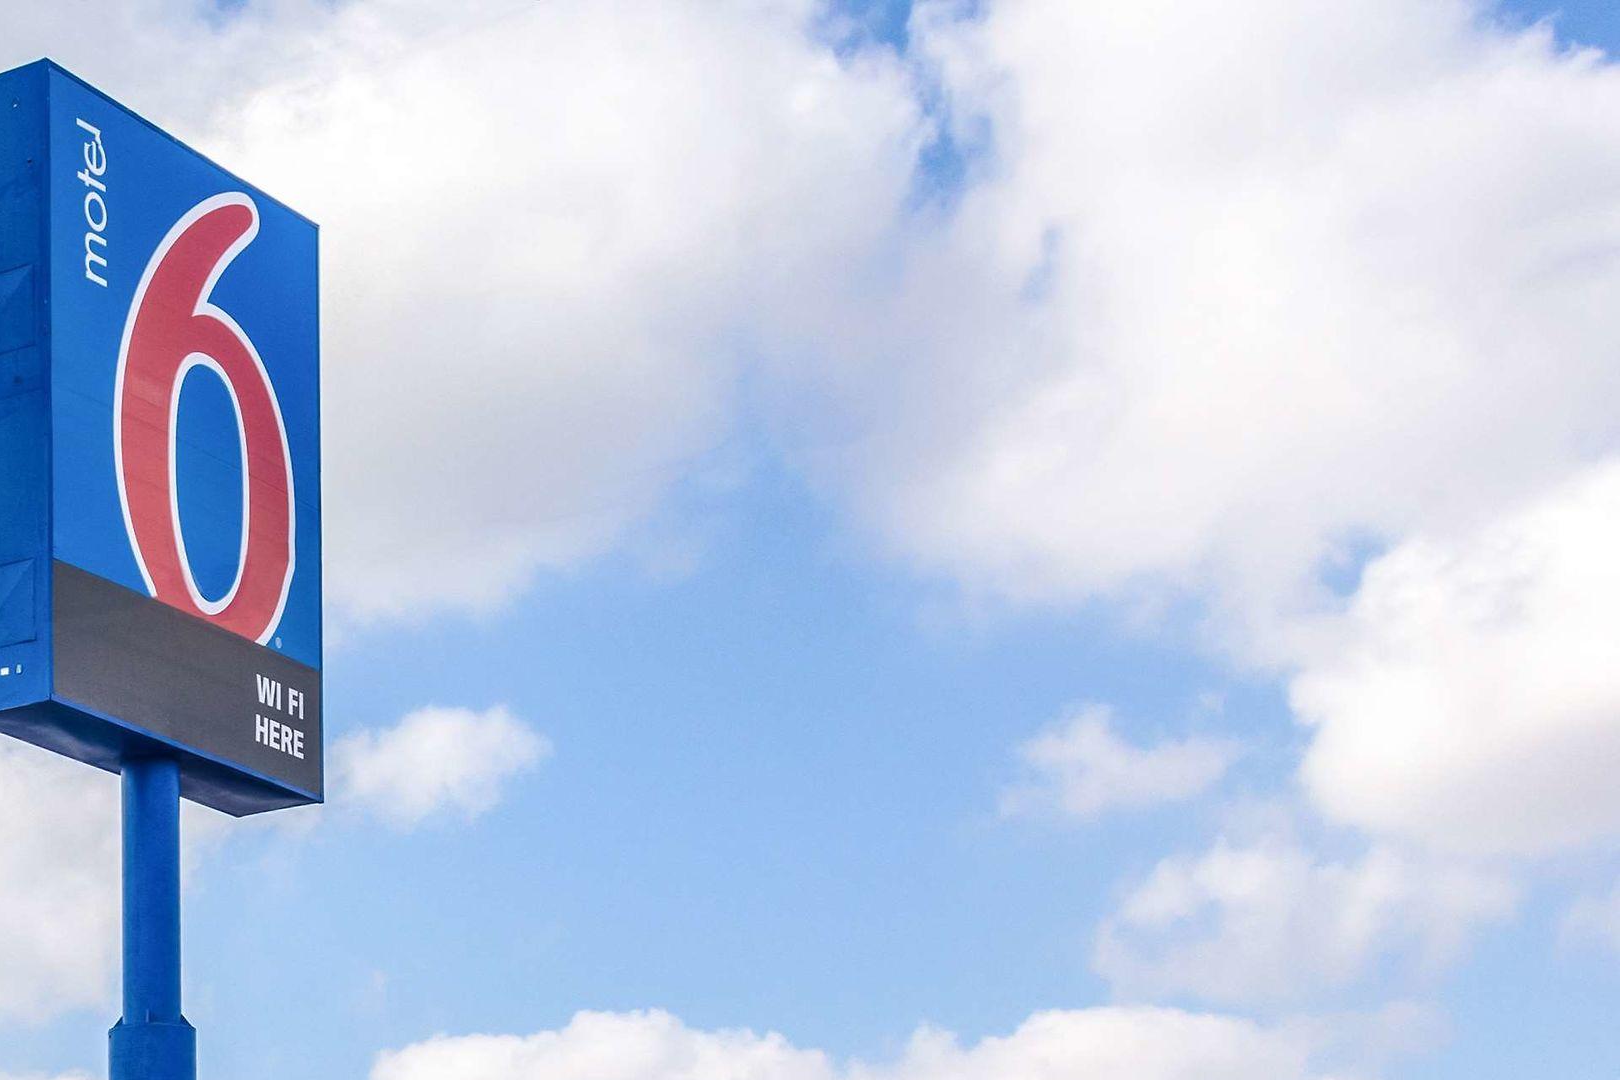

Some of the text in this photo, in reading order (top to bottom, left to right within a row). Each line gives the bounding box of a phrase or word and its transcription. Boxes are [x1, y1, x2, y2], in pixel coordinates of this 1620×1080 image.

[76, 117, 108, 288] motel
[113, 190, 296, 647] 6
[255, 713, 305, 760] HERE
[256, 673, 304, 720] WI FI
